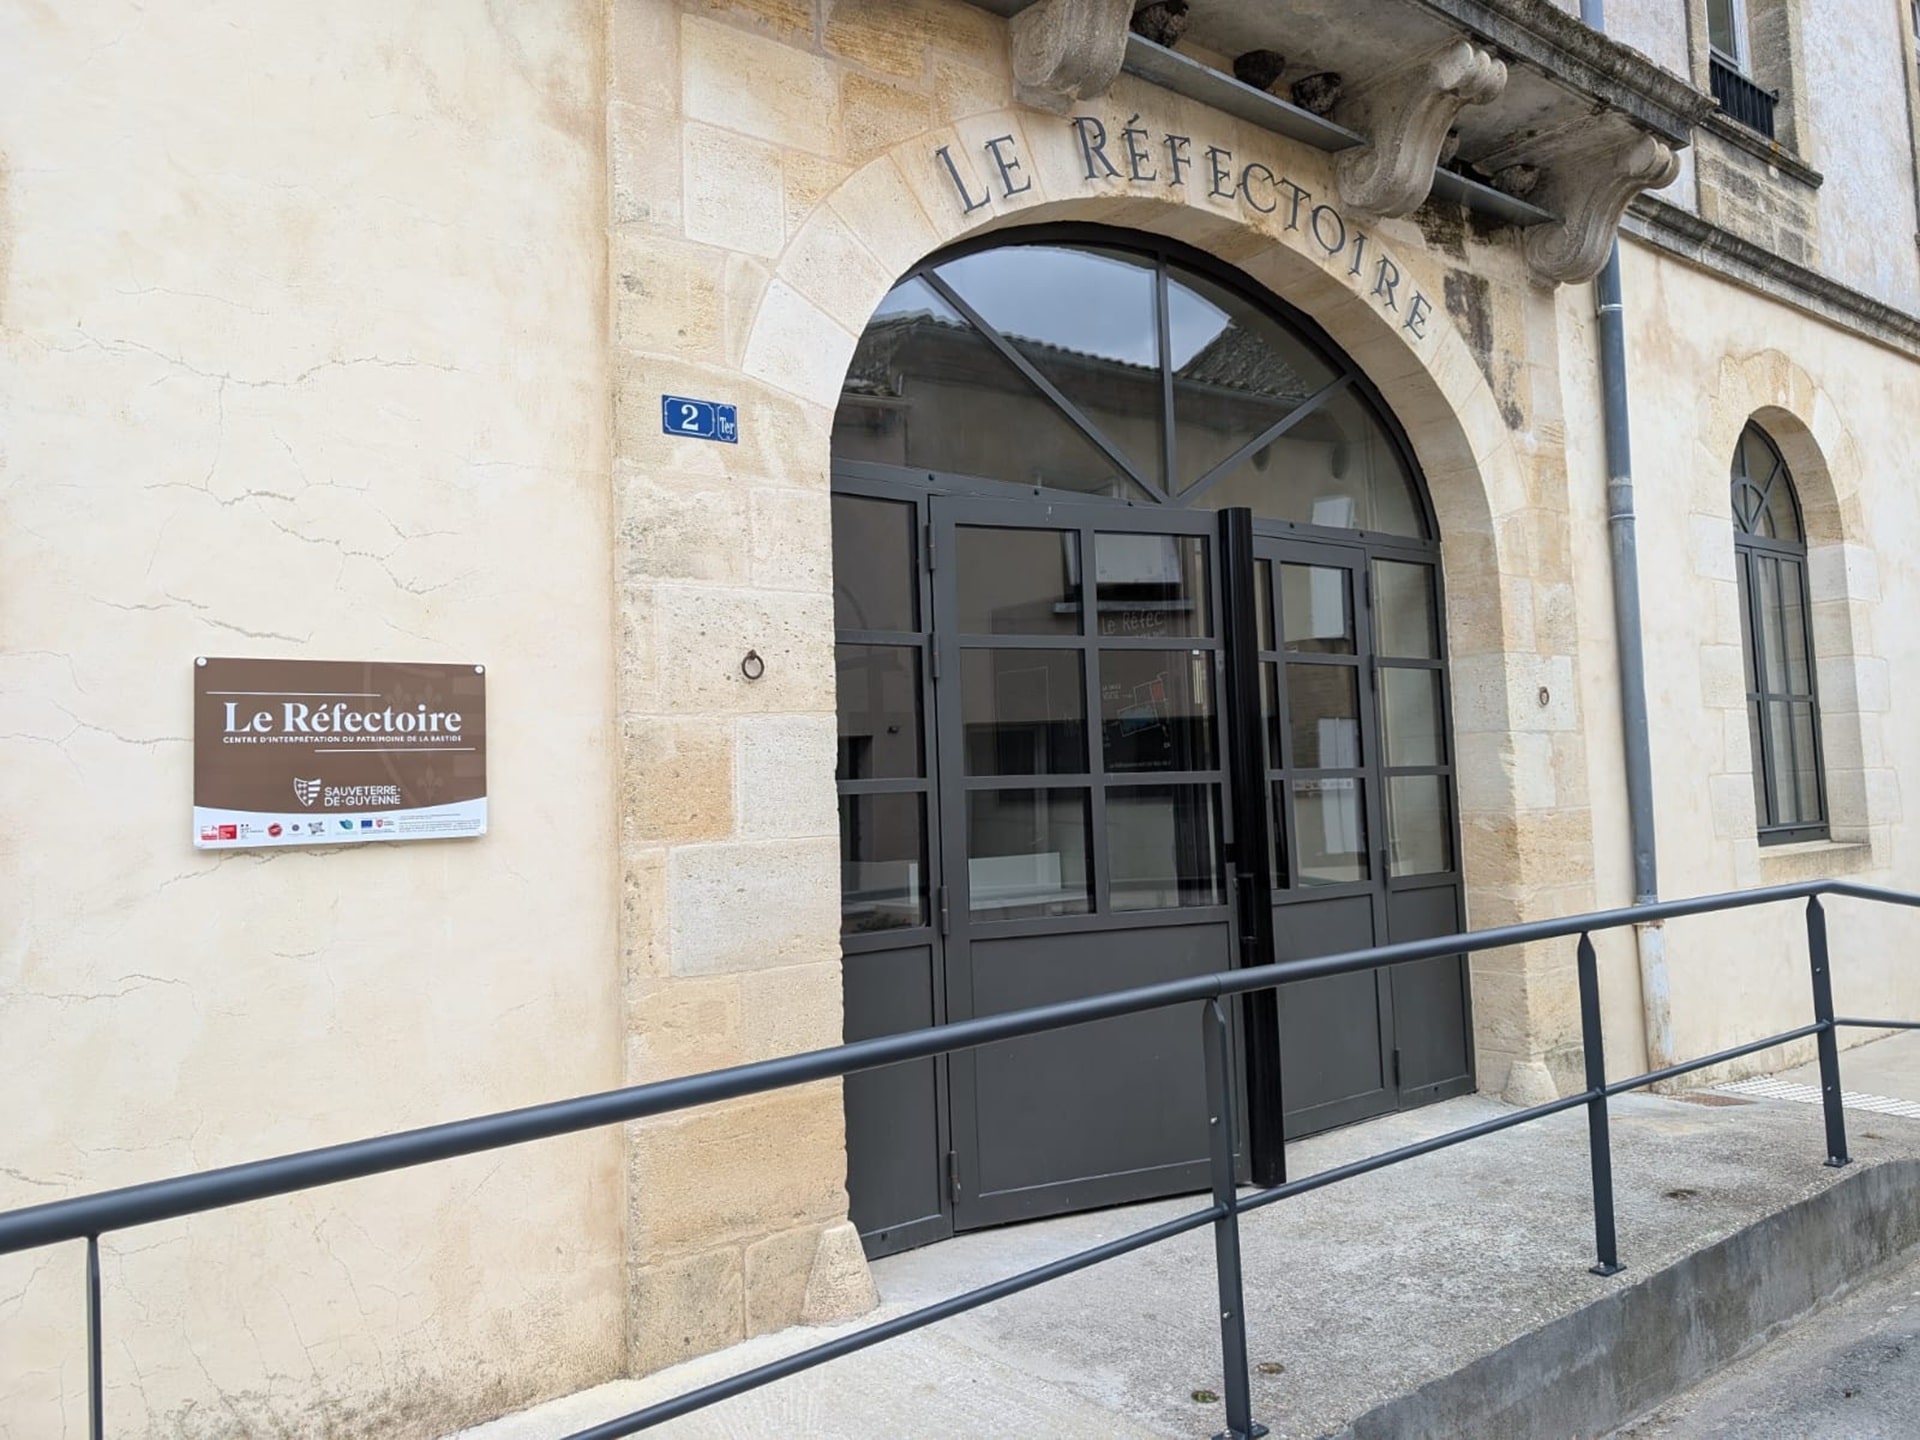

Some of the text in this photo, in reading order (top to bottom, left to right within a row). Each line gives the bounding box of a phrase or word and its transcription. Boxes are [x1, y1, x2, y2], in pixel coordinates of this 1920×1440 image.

[936, 114, 1433, 340] LE RÉFECTOIRE
[681, 404, 735, 435] 2 Ter
[223, 701, 462, 733] Le Réfectoire
[223, 736, 257, 744] CENTRE
[260, 735, 340, 744] D'INTERPRÉTATION
[342, 735, 354, 743] DU
[356, 735, 404, 743] PATRIMOINE
[431, 734, 462, 742] BASTIDE
